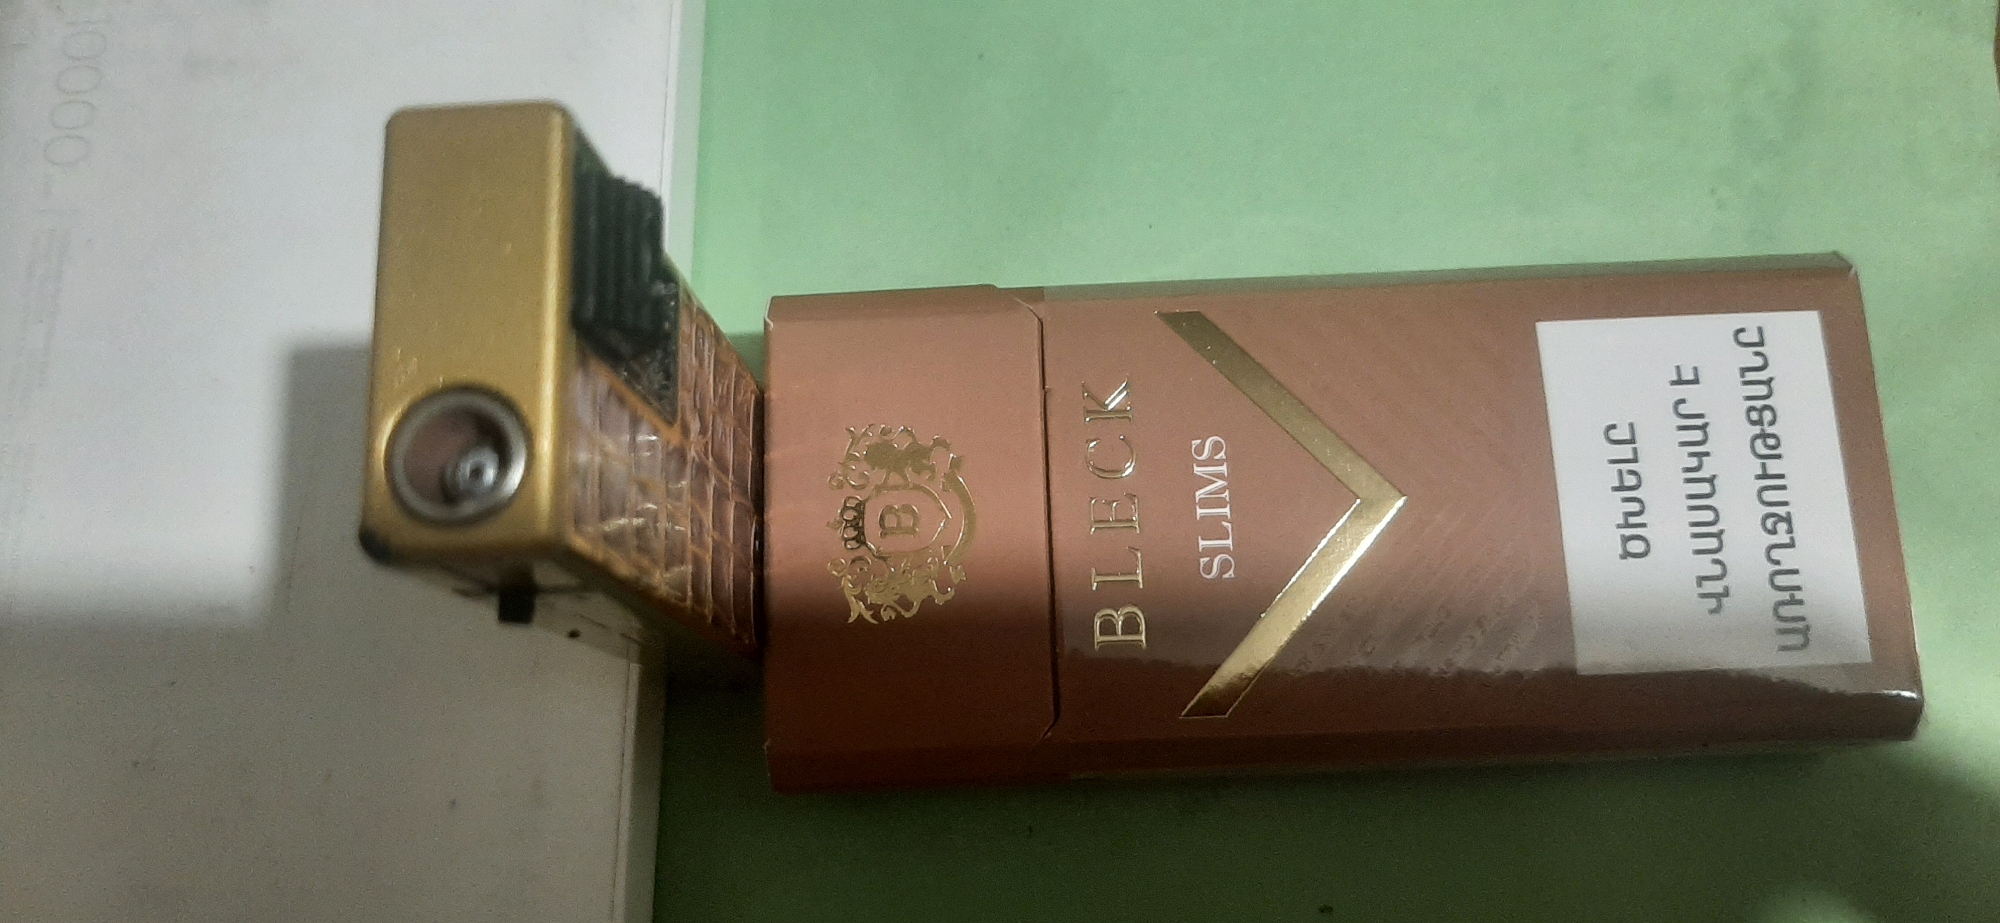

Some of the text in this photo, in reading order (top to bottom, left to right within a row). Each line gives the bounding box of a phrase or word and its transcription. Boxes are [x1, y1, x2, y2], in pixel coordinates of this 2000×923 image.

[878, 503, 920, 539] B
[1081, 373, 1147, 651] BLECK
[1191, 435, 1235, 579] SLIMS
[1602, 421, 1652, 561] ԾԽԵԼԸ
[1668, 364, 1731, 616] ՎՆԱՍԱԿԱՐ Է
